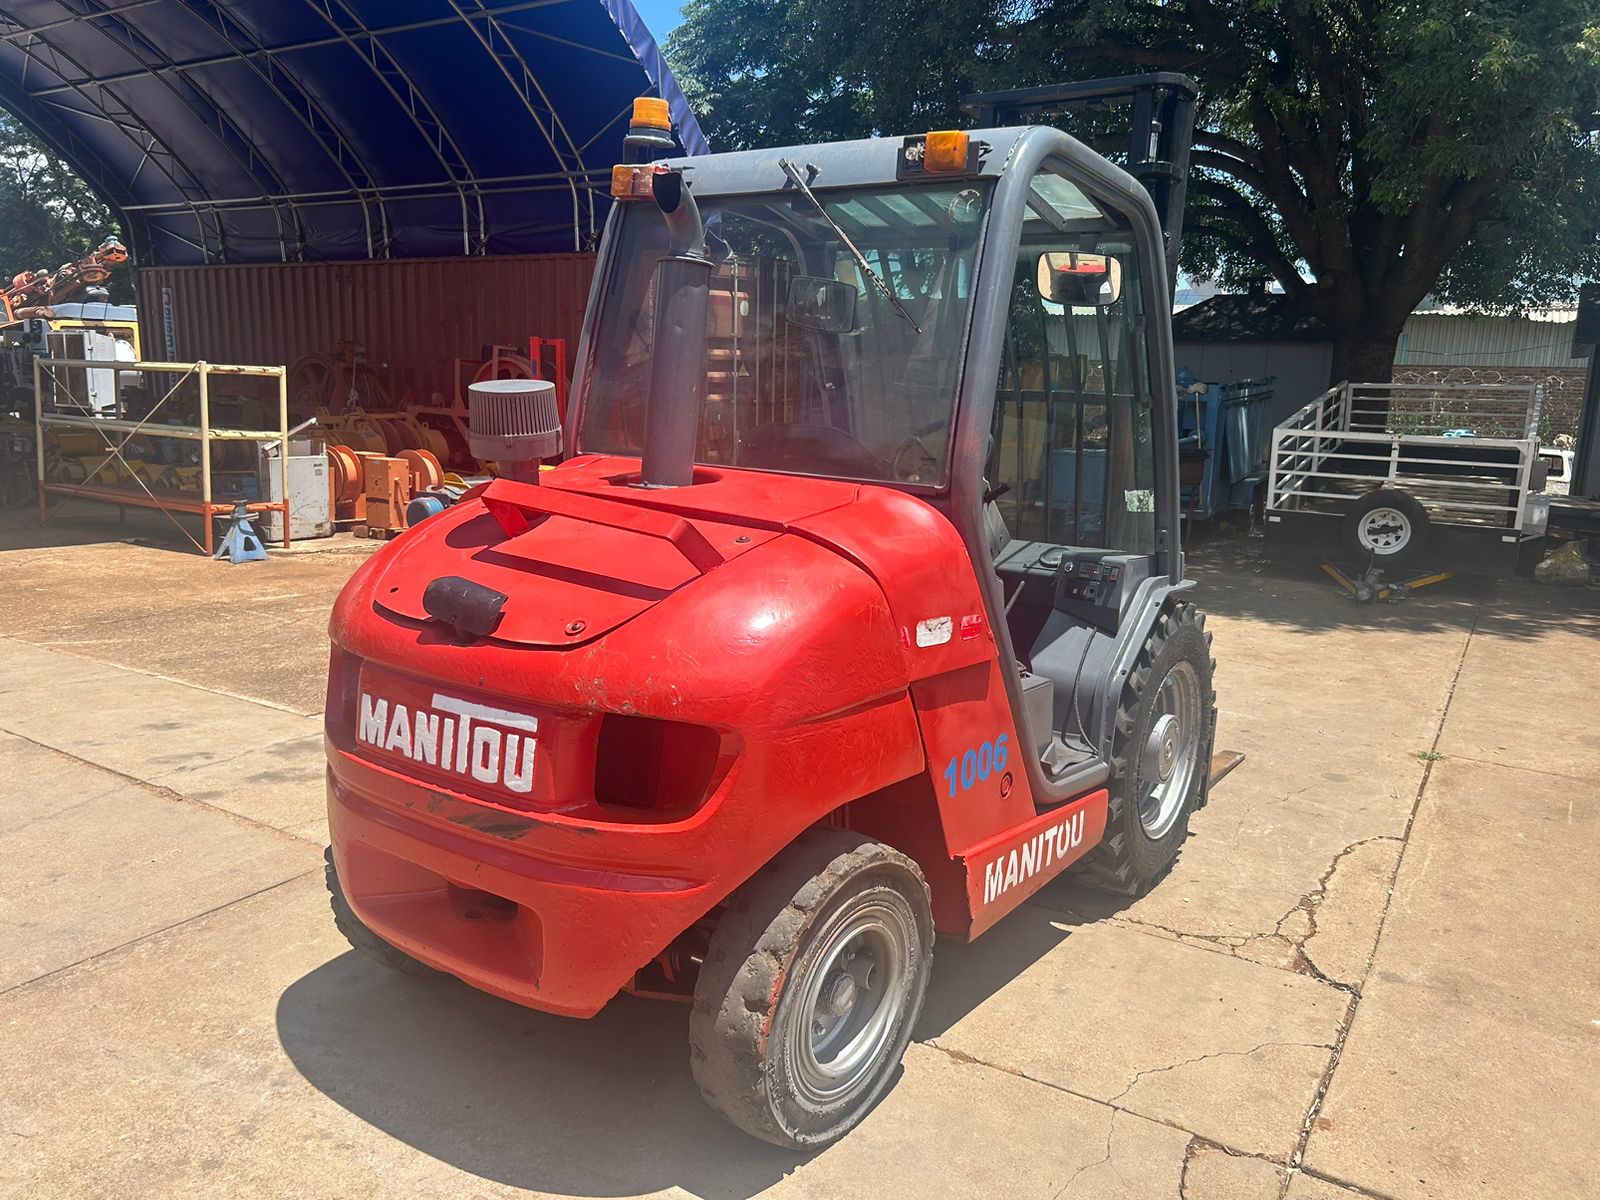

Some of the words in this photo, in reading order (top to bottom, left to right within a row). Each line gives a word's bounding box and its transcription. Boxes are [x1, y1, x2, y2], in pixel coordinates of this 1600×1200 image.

[359, 693, 539, 793] MANITOU
[943, 732, 1009, 798] 1006
[983, 809, 1086, 905] MANITOU
